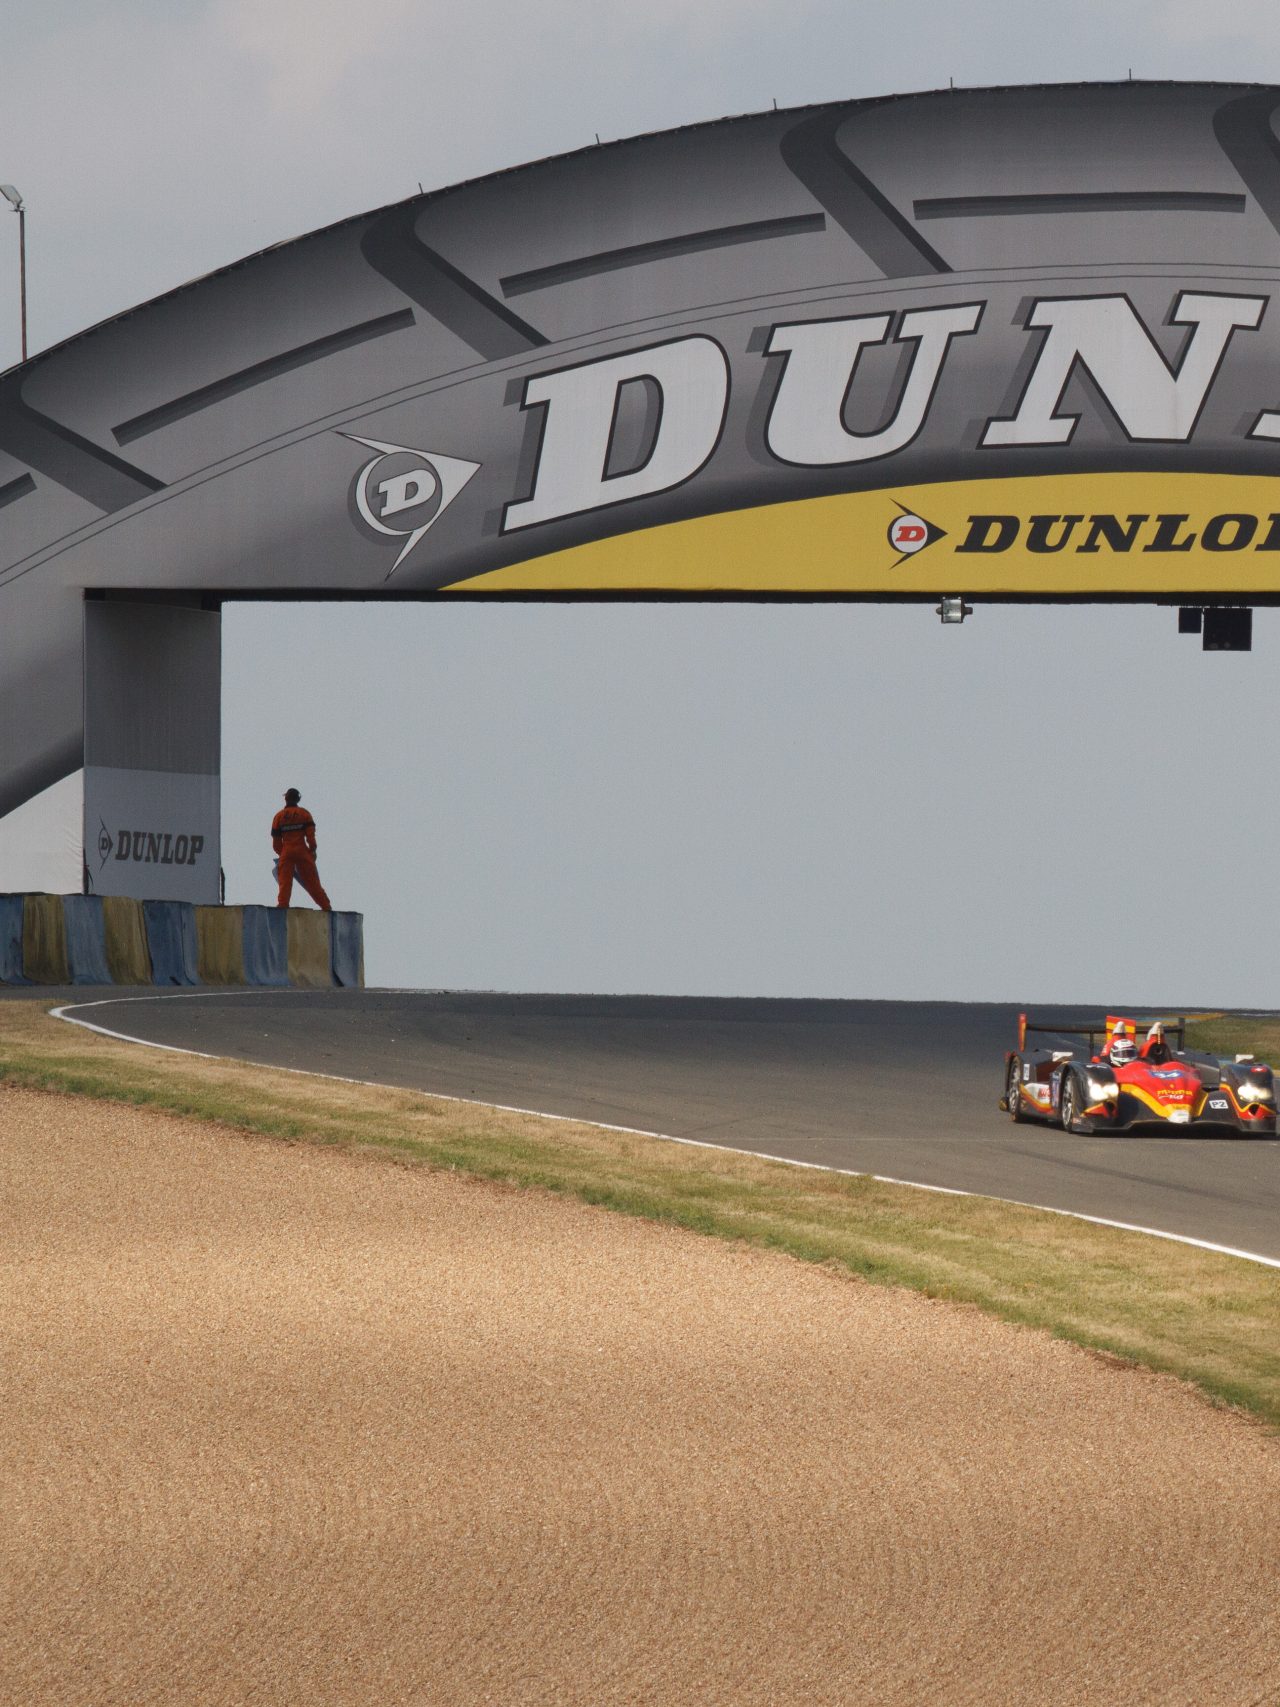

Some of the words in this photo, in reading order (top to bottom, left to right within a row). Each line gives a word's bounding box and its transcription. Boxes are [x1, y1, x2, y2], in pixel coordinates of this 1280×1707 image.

[378, 468, 437, 518] D
[894, 525, 925, 542] D
[115, 829, 204, 865] DUNLOP
